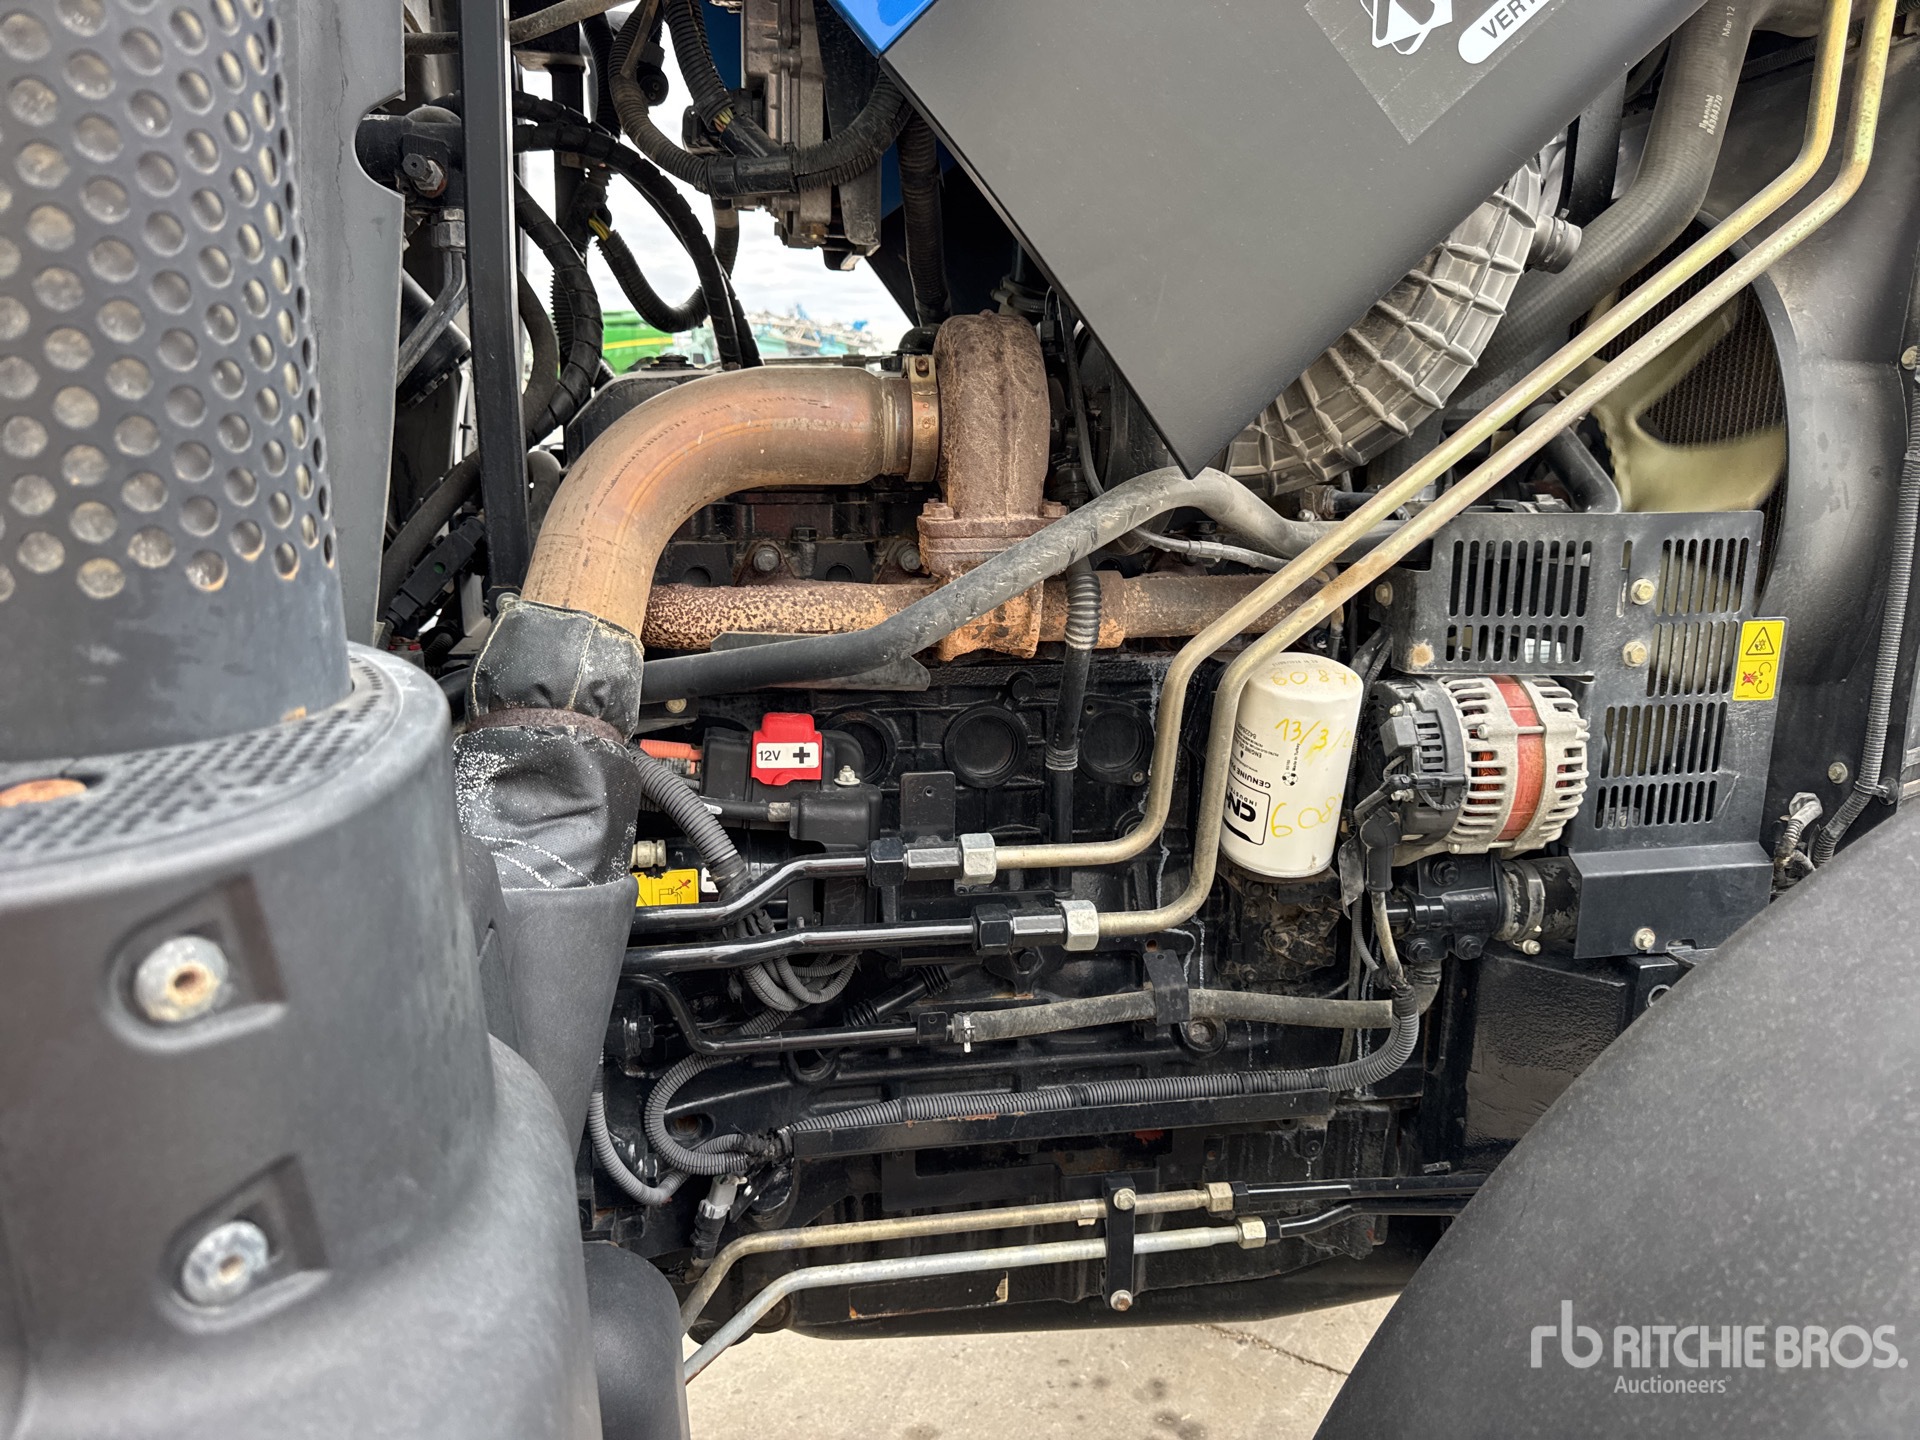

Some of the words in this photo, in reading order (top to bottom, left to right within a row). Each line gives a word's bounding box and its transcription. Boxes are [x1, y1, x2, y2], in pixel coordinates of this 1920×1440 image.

[1726, 5, 1736, 17] 12
[1722, 19, 1732, 38] Mar
[758, 750, 781, 761] 12V
[1236, 767, 1271, 789] GENUINE
